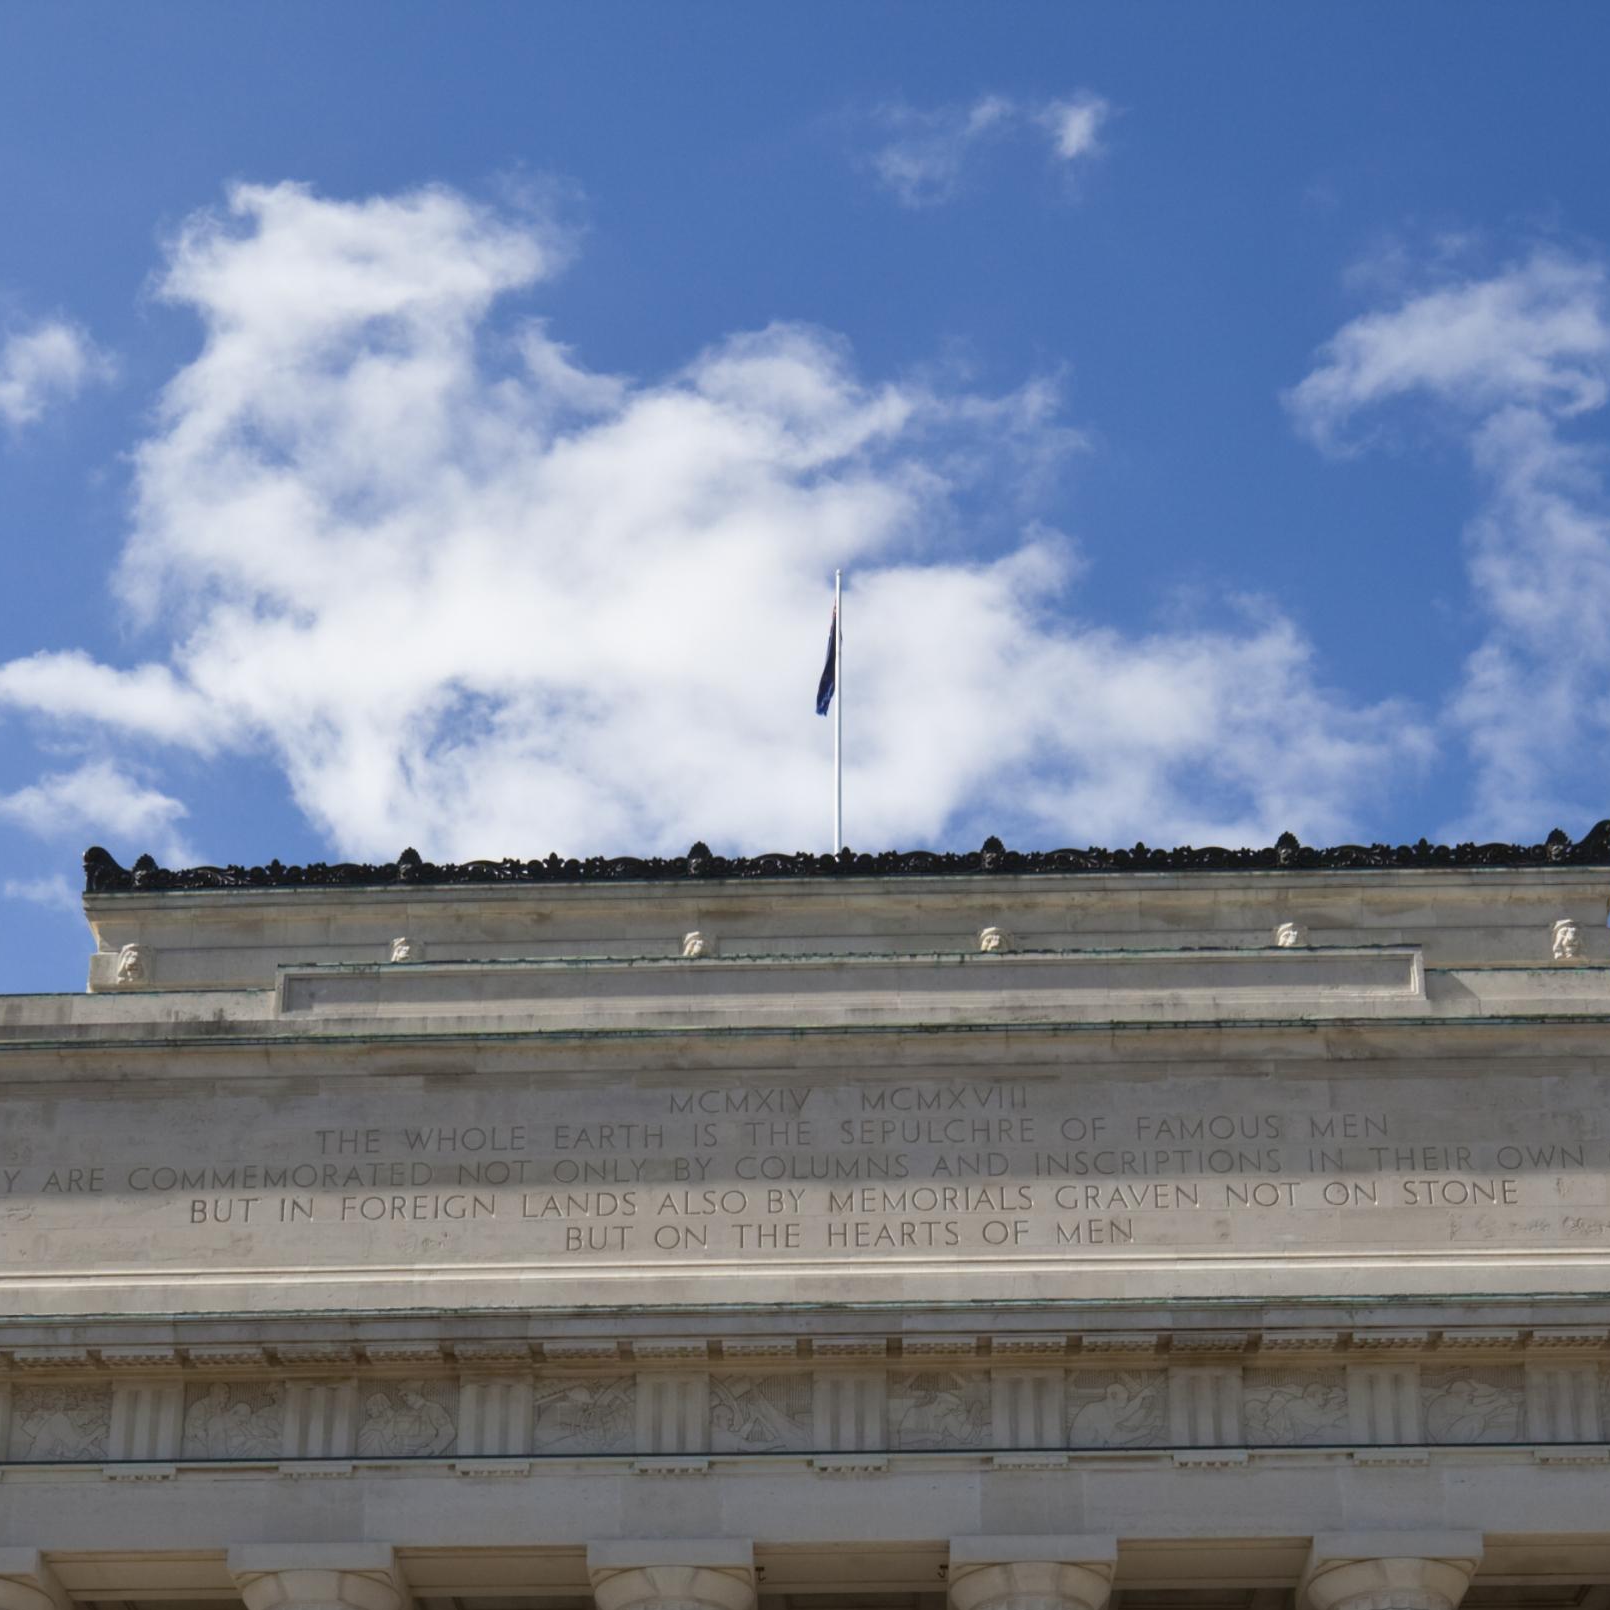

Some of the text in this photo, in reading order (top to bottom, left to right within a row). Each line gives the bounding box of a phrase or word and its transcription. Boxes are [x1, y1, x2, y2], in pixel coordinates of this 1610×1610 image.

[670, 1085, 1027, 1114] MCMXIV MCMXVIII
[315, 1114, 1388, 1154] THE WHOLE EARTH IS THE SEPULCHRE OF FAMOUS MEN
[42, 1168, 105, 1192] ARE
[128, 1162, 433, 1191] COMMEMORATED
[459, 1160, 532, 1185] NOT
[554, 1159, 647, 1184] ONLY
[674, 1157, 712, 1182] BY
[736, 1154, 910, 1180] COLUMNS
[932, 1152, 1009, 1177] AND
[1035, 1149, 1282, 1176] INSCRIPTIONS
[1309, 1148, 1343, 1173] IN
[1369, 1146, 1474, 1172] THEIR
[1497, 1145, 1584, 1170] OWN
[190, 1179, 1518, 1224] BUT IN FOREIGN LANDS ALSO BY MEMORIALS GRAVEN NOT ON STONE
[566, 1218, 1132, 1251] BUT ON THE HEARTS OF MEN
